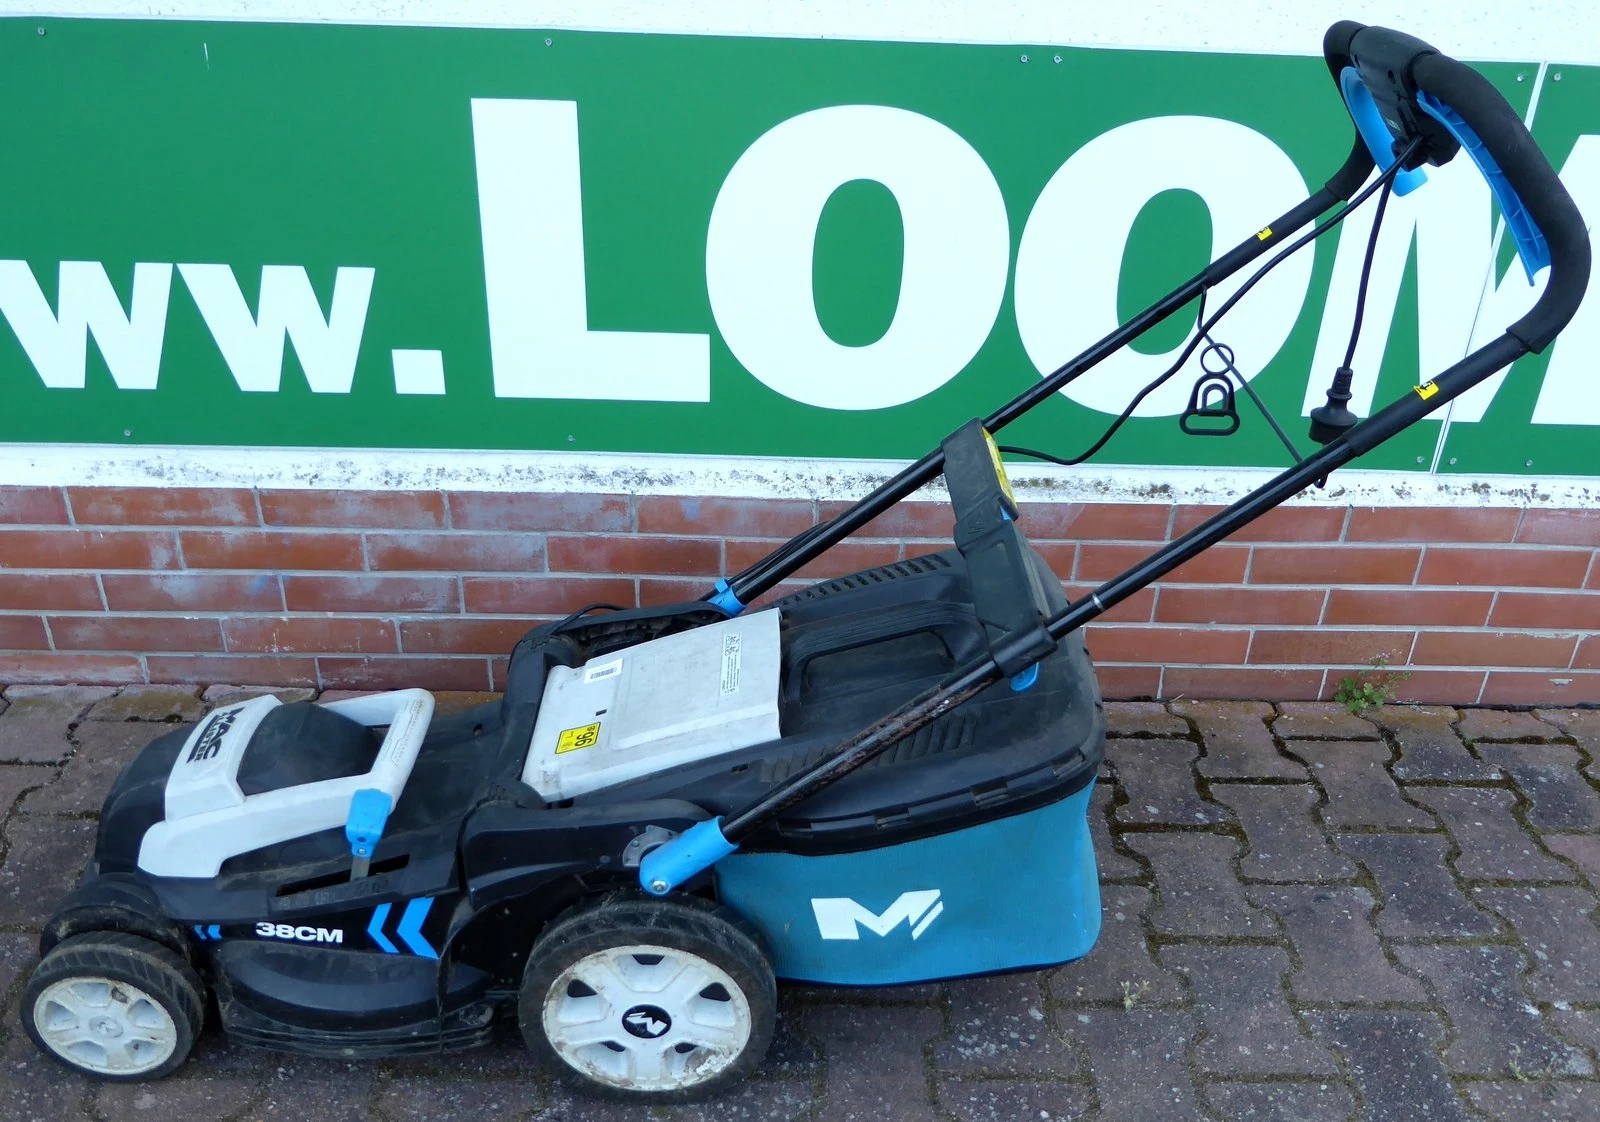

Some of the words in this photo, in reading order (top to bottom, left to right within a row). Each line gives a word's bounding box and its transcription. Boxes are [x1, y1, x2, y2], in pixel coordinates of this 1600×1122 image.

[0, 98, 1600, 424] ww.LOOM
[202, 707, 245, 760] MAC
[574, 731, 594, 746] 96
[256, 921, 343, 943] 38CM
